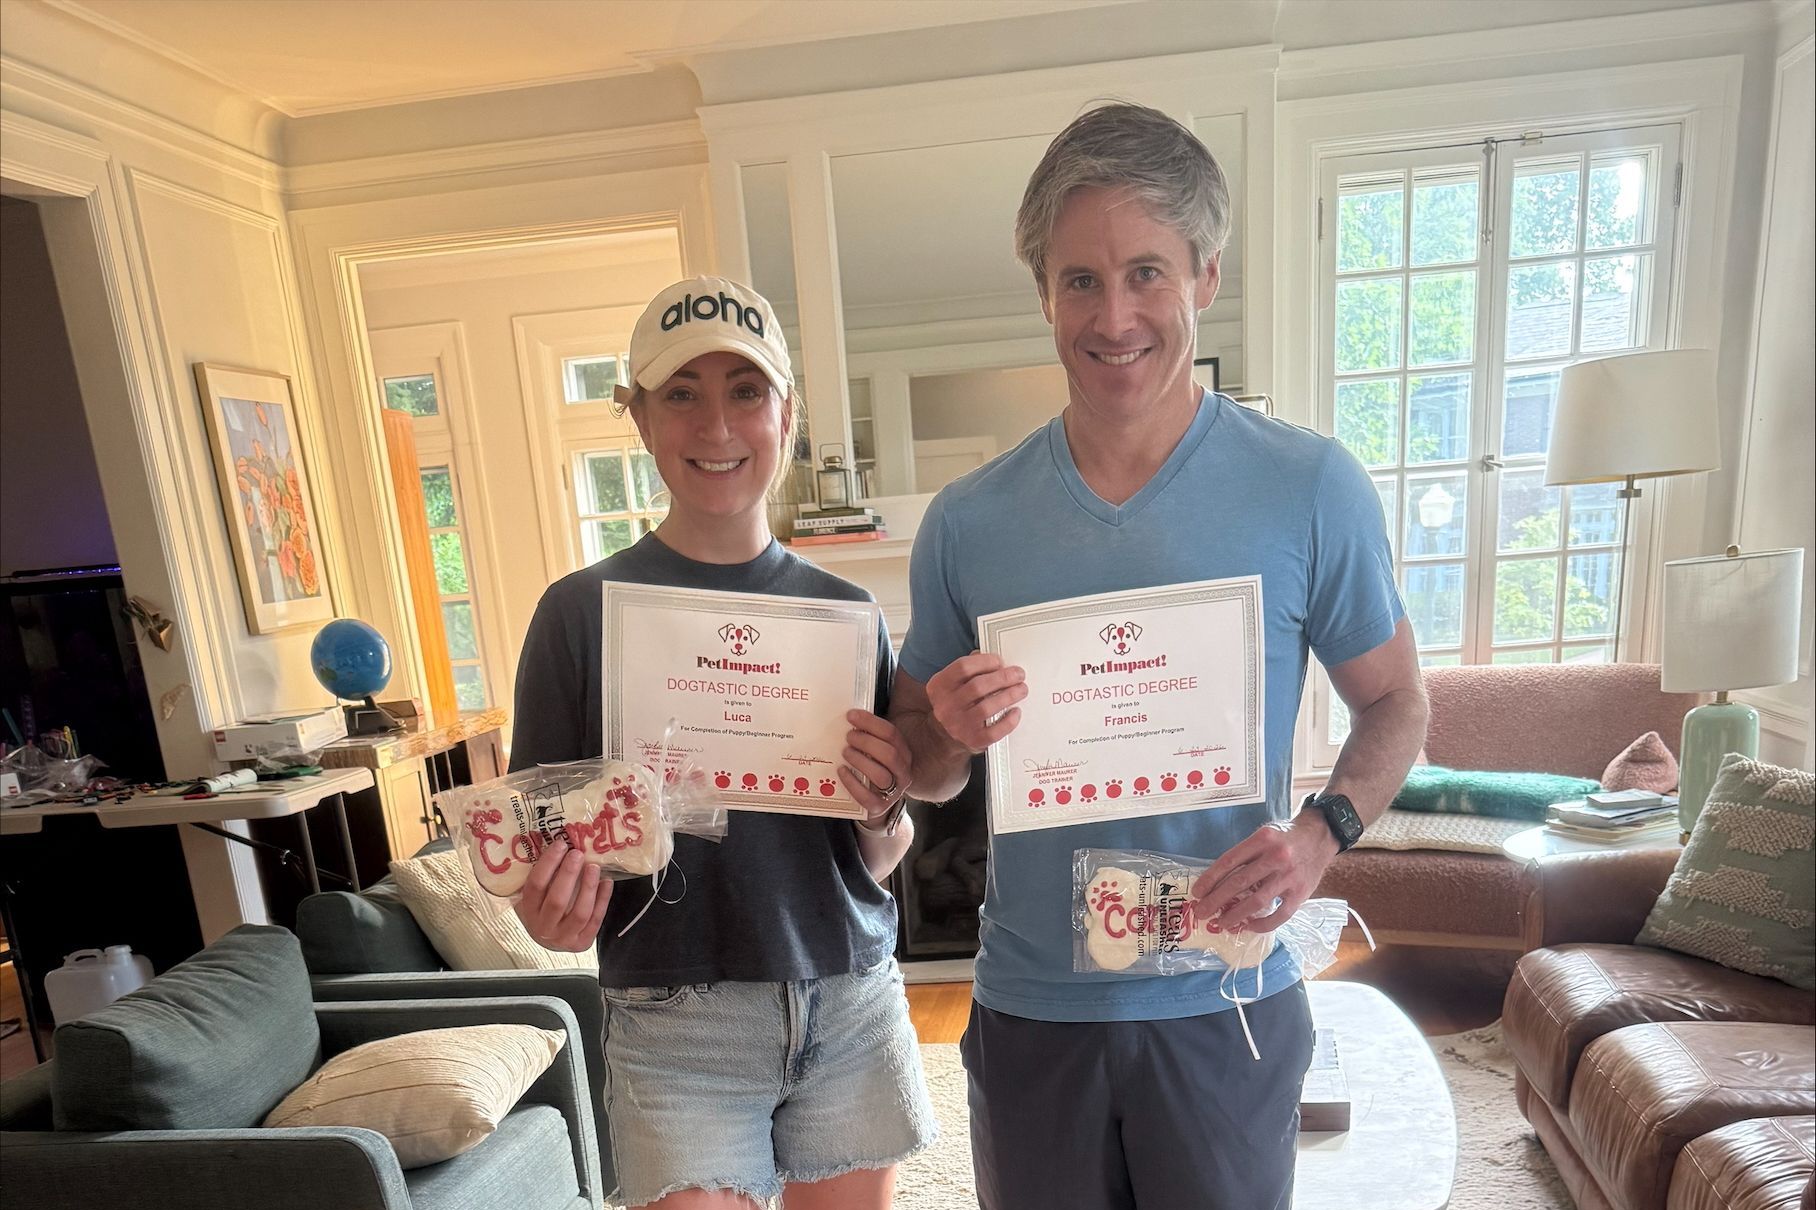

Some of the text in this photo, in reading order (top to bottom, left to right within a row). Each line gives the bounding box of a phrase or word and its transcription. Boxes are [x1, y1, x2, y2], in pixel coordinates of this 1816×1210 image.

[661, 291, 764, 339] aloha
[818, 518, 844, 526] SUPPLY
[697, 655, 781, 675] PetImpact!
[1080, 654, 1167, 676] PetImpact!
[667, 678, 809, 701] DOGTASTIC DEGREE
[1052, 676, 1198, 705] DOGTASTIC DEGREE
[1118, 701, 1133, 710] given
[724, 711, 752, 723] Luca
[1104, 712, 1148, 727] Francis
[690, 726, 721, 736] Completion
[771, 732, 795, 740] Program
[1079, 735, 1110, 745] Completion
[1161, 726, 1185, 736] Program
[1056, 768, 1078, 776] MAURER
